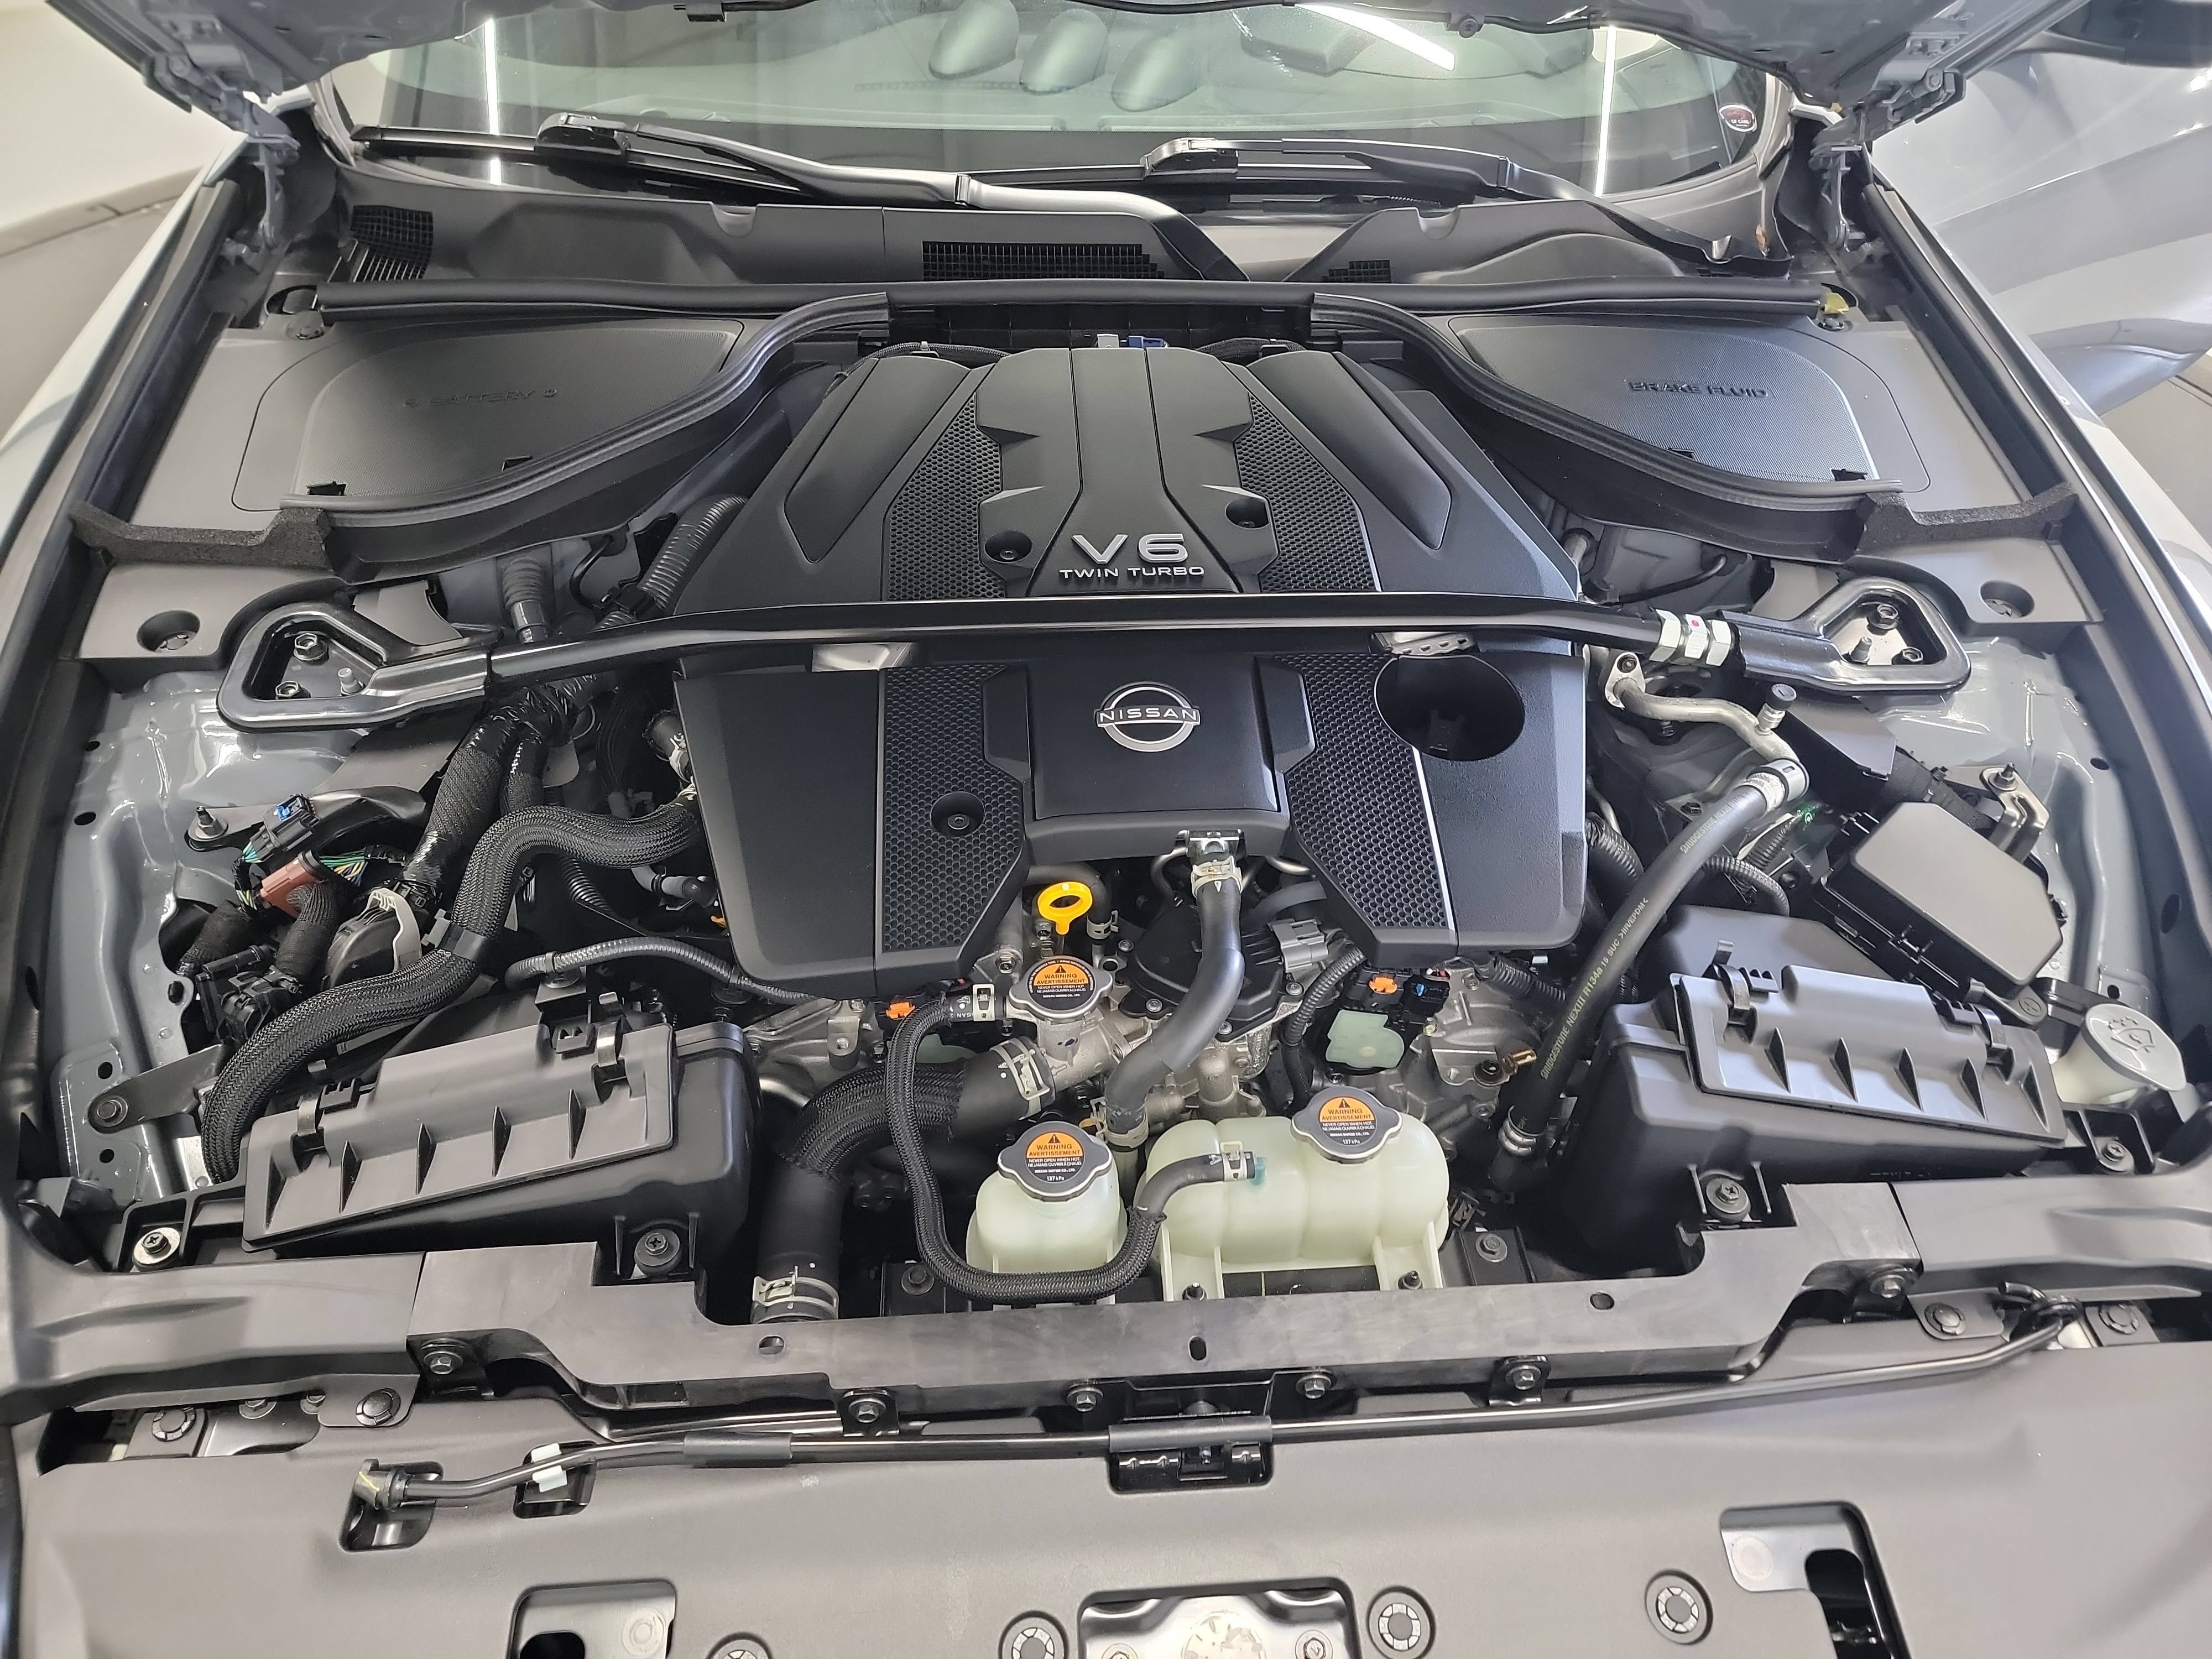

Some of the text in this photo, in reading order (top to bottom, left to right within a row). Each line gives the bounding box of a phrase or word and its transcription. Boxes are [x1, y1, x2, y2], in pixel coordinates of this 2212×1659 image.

[429, 389, 535, 406] BATTERY
[1629, 382, 1768, 398] BRAKE FLUID
[1071, 533, 1188, 564] V6
[1060, 566, 1205, 579] TWIN TURBO
[1099, 707, 1198, 723] NISSAN
[1540, 1026, 1570, 1079] BRIDGESTONE
[1583, 967, 1603, 997] R134a
